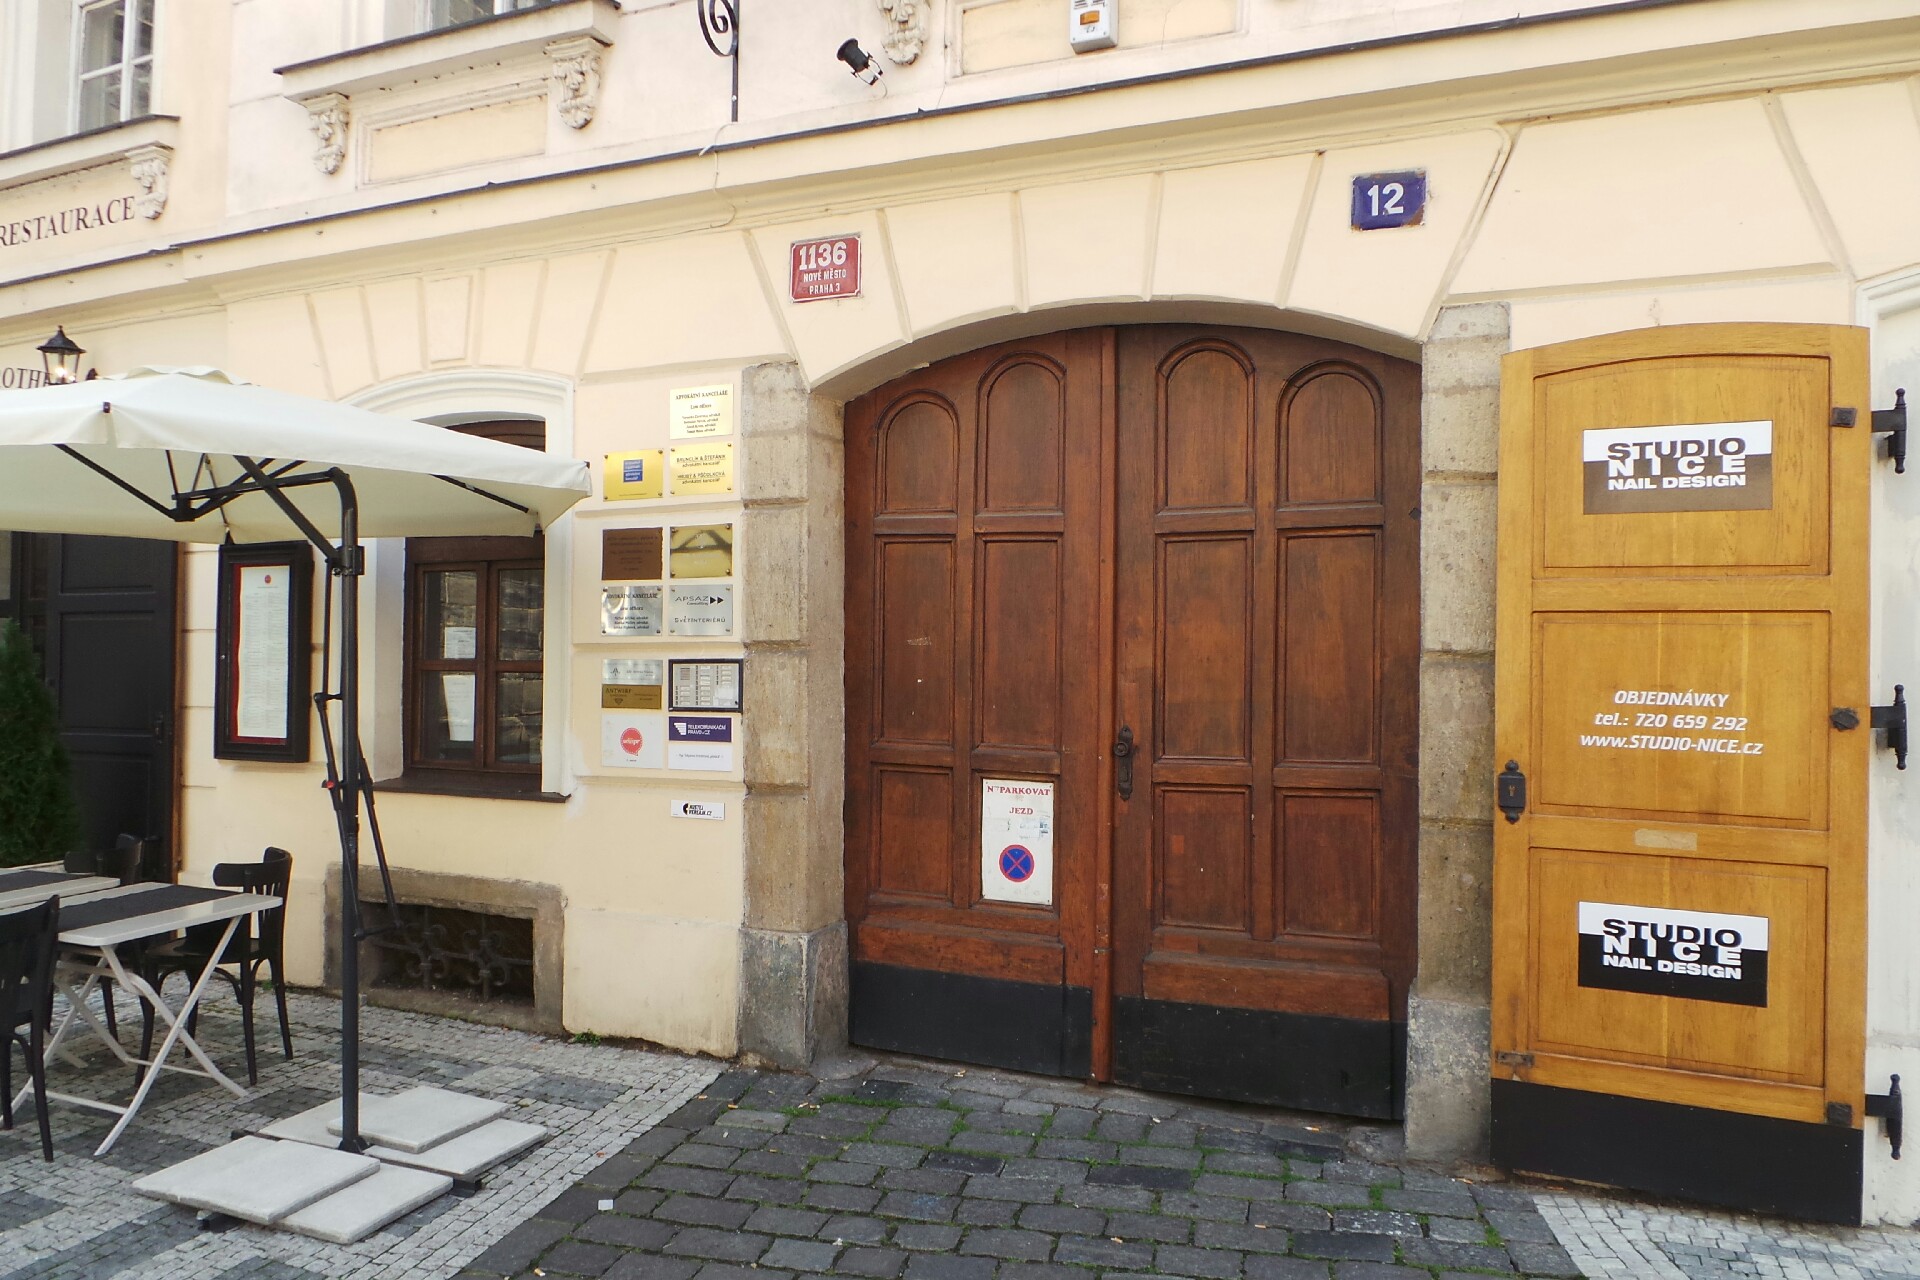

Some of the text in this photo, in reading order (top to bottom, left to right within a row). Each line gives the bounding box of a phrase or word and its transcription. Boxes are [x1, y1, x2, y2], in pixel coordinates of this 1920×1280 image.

[1368, 182, 1404, 216] 12
[0, 196, 135, 246] RESTAURACE
[799, 242, 846, 270] 1136
[804, 268, 846, 282] NOVÉ MĚSTO
[810, 283, 840, 294] PRAHA 3
[1608, 437, 1746, 461] STUDIO
[1608, 454, 1746, 477] NICE
[1608, 474, 1746, 491] NAIL DESIGN
[1614, 689, 1729, 707] OBJEDNÁVKY
[1595, 712, 1748, 731] tel.: 720 659 292
[1580, 735, 1764, 755] www.STUDIO-NICE.cz
[1603, 918, 1742, 948] STUDIO
[1603, 934, 1742, 966] NICE
[1603, 954, 1742, 980] NAIL DESIGN
